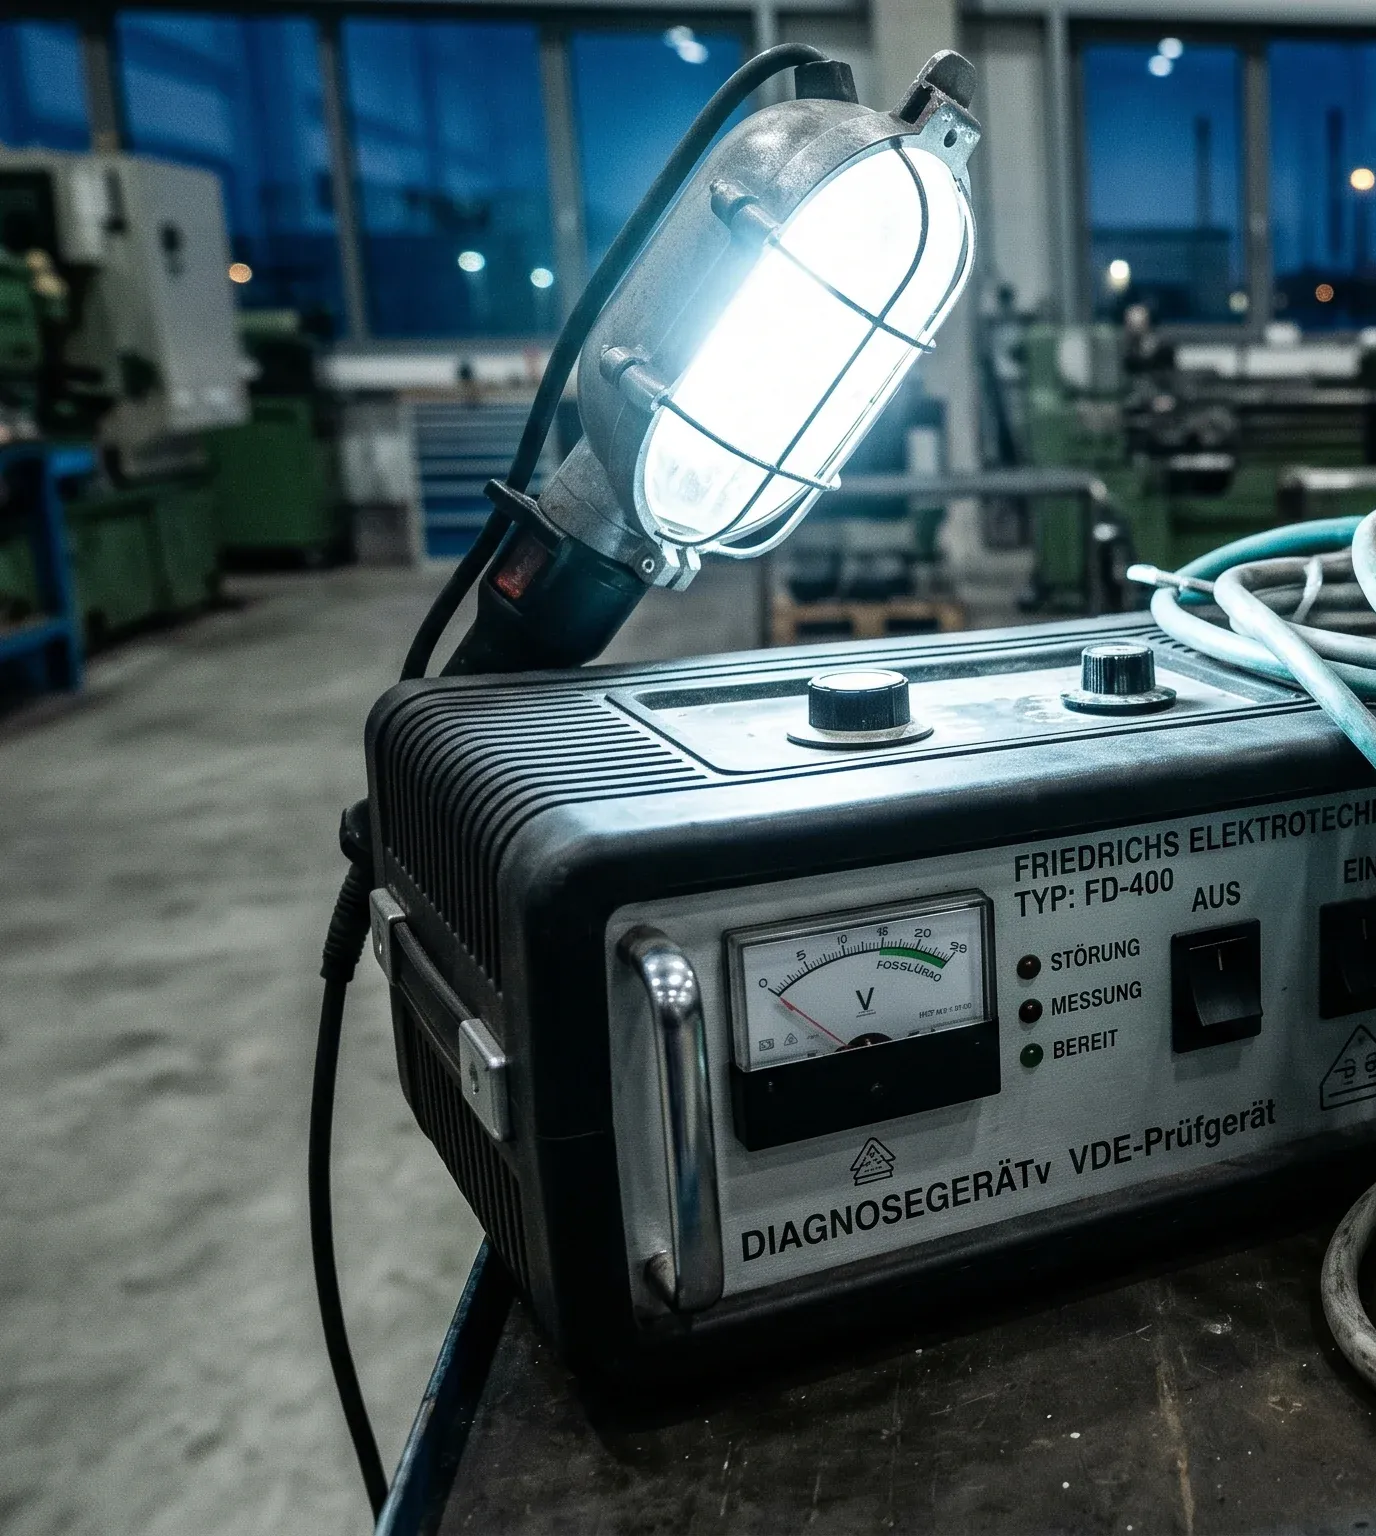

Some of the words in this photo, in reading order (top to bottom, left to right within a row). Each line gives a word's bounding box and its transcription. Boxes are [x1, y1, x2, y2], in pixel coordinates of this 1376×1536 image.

[1014, 830, 1180, 882] FRIEDRICHS
[1014, 884, 1075, 917] TYP:
[1085, 868, 1174, 905] FD-400
[1191, 881, 1241, 912] AUS
[796, 950, 807, 961] 5
[837, 935, 847, 945] 10
[914, 928, 931, 938] 20
[1051, 938, 1140, 971] STÖRUNG
[856, 987, 874, 1011] V
[1052, 981, 1142, 1015] MESSUNG
[1053, 1029, 1118, 1059] BEREIT
[741, 1158, 1051, 1262] DIAGNOSEGERÄTv
[1069, 1099, 1276, 1175] VDE-Prüfgerät
